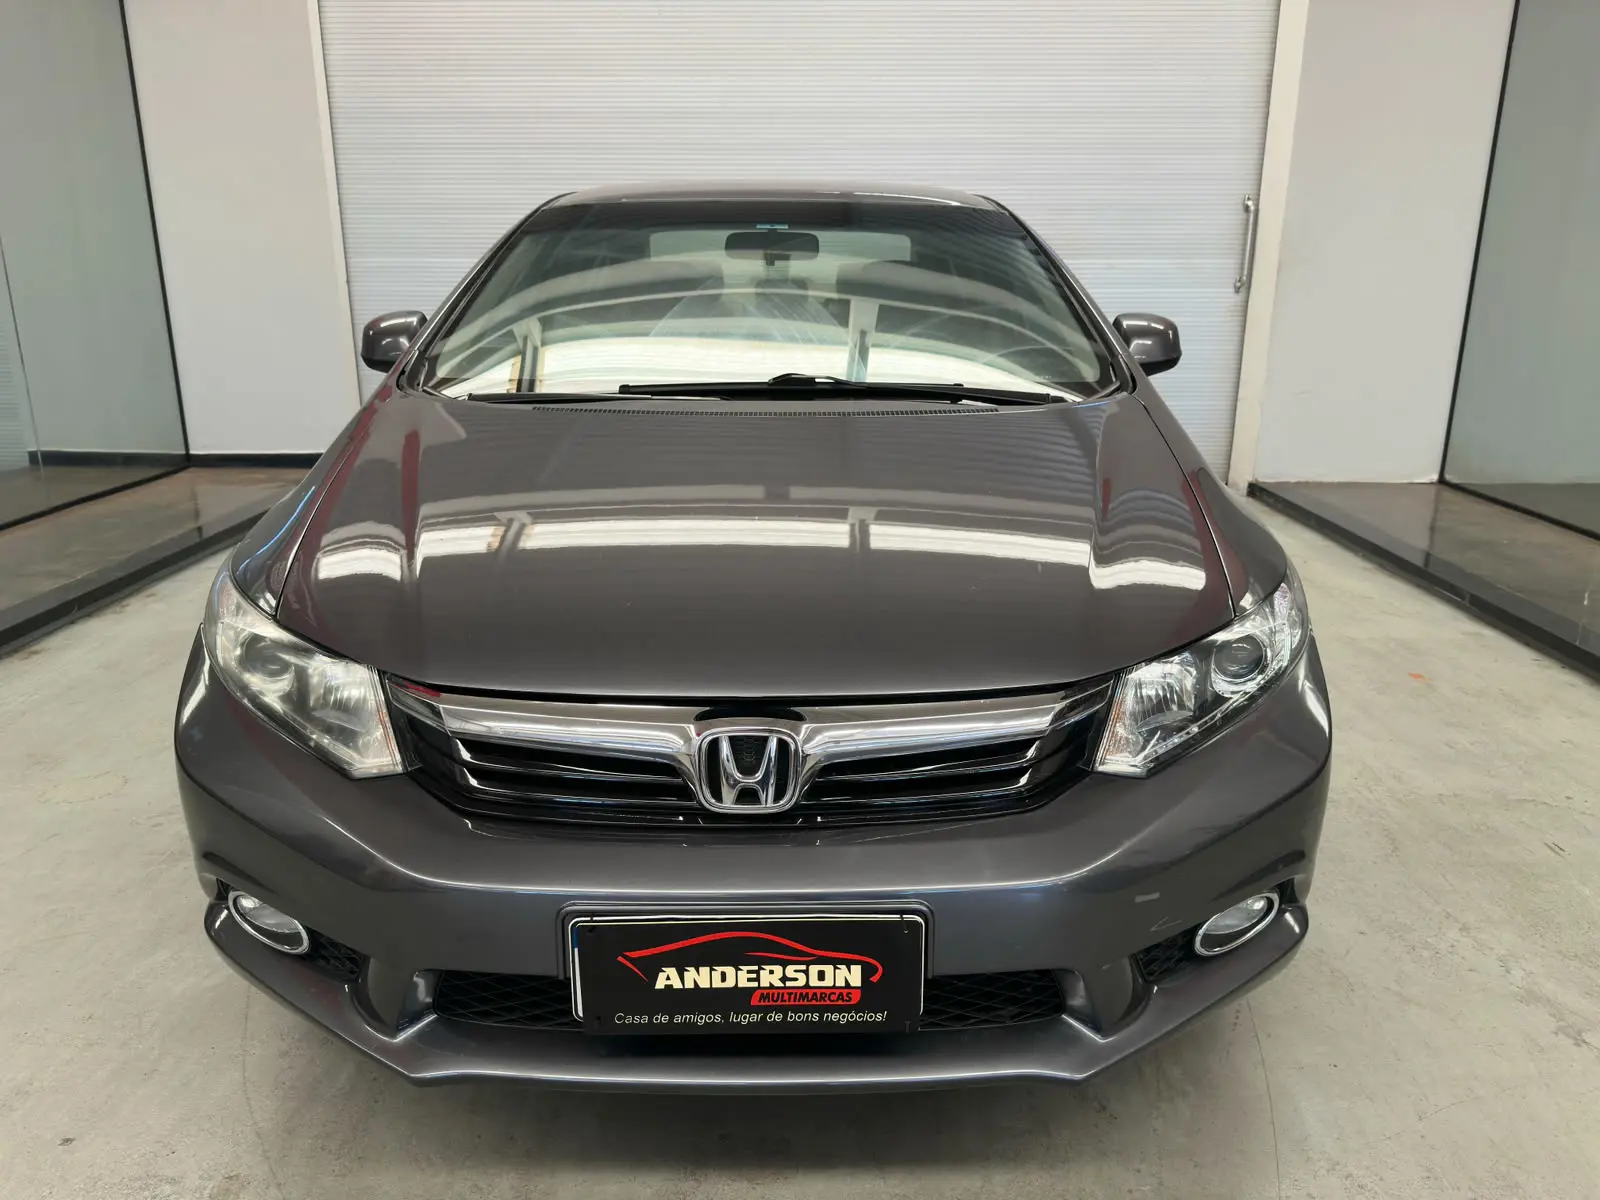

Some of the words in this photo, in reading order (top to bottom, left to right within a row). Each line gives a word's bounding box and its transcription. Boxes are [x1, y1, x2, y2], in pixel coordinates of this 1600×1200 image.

[654, 964, 862, 989] ANDERSON
[758, 991, 853, 1004] MULTIMARCAS
[614, 1012, 649, 1024] Casa
[652, 1012, 670, 1024] de
[673, 1011, 725, 1026] amigos,
[729, 1011, 764, 1025] lugar
[766, 1010, 783, 1022] de
[787, 1010, 820, 1022] bons
[823, 1010, 888, 1025] negócios!
